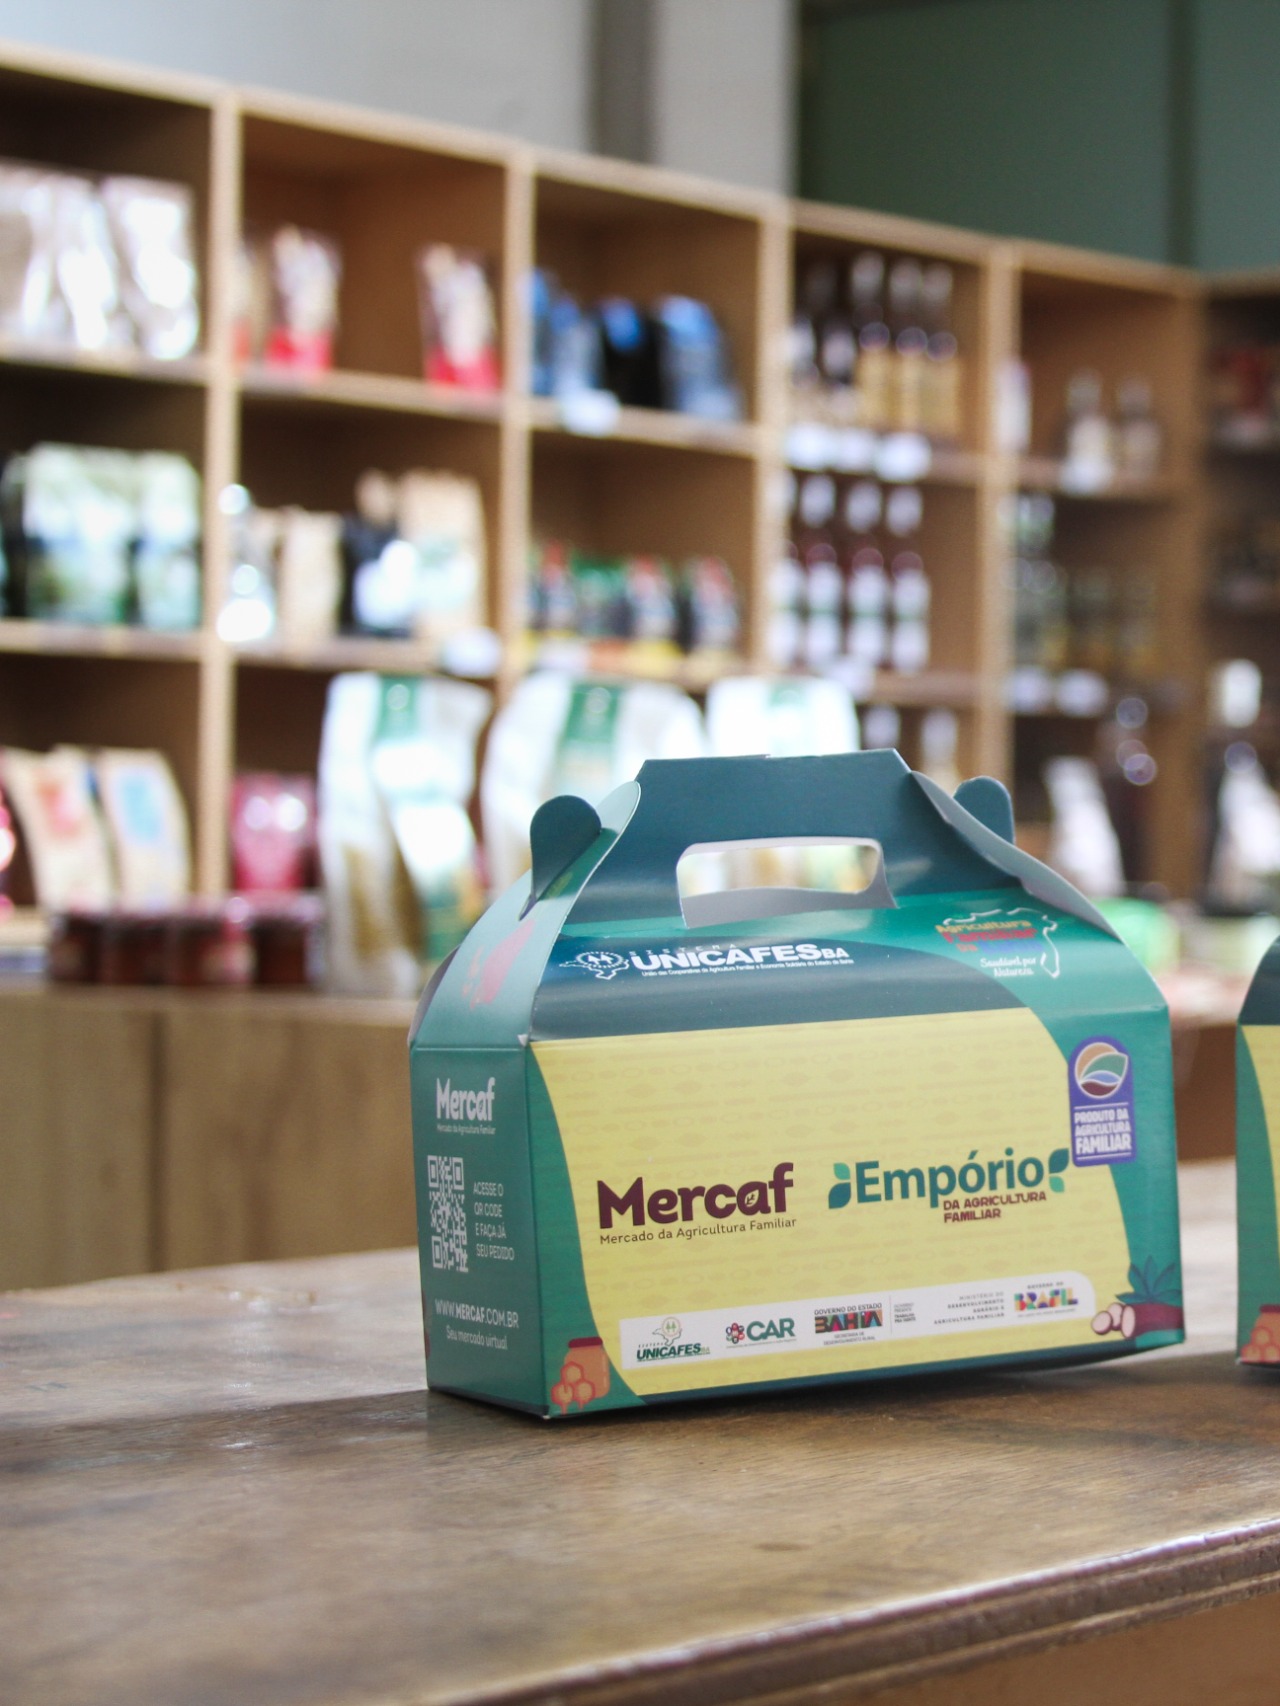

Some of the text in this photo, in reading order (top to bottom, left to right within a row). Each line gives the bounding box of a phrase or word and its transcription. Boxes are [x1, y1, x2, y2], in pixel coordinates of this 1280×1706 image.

[436, 1076, 496, 1121] Mercaf
[1074, 1107, 1129, 1124] PRODUTO DA
[1074, 1120, 1131, 1137] AGRICULTURA
[1076, 1133, 1132, 1155] FAMILIAR
[473, 1181, 504, 1197] ACESSE O
[855, 1147, 1044, 1209] Empório
[597, 1162, 794, 1229] Mercaf
[943, 1191, 1047, 1211] DA AGRICULTURA
[484, 1203, 503, 1218] CODE
[944, 1208, 1002, 1224] FAMILIAR
[475, 1221, 507, 1241] E FAÇA JÁ
[599, 1217, 797, 1245] Mercado da Agricultura Familiar
[476, 1242, 515, 1261] SEU PEDIDO
[814, 1306, 846, 1316] GOVERNO
[858, 1302, 883, 1311] ESTADO
[1013, 1287, 1079, 1312] BRASIL
[434, 1298, 519, 1329] WWW.MERCAF.COM.BR
[815, 1309, 883, 1334] BAHIA
[446, 1324, 508, 1351] Seu mercado virtual
[746, 1317, 796, 1341] CAR
